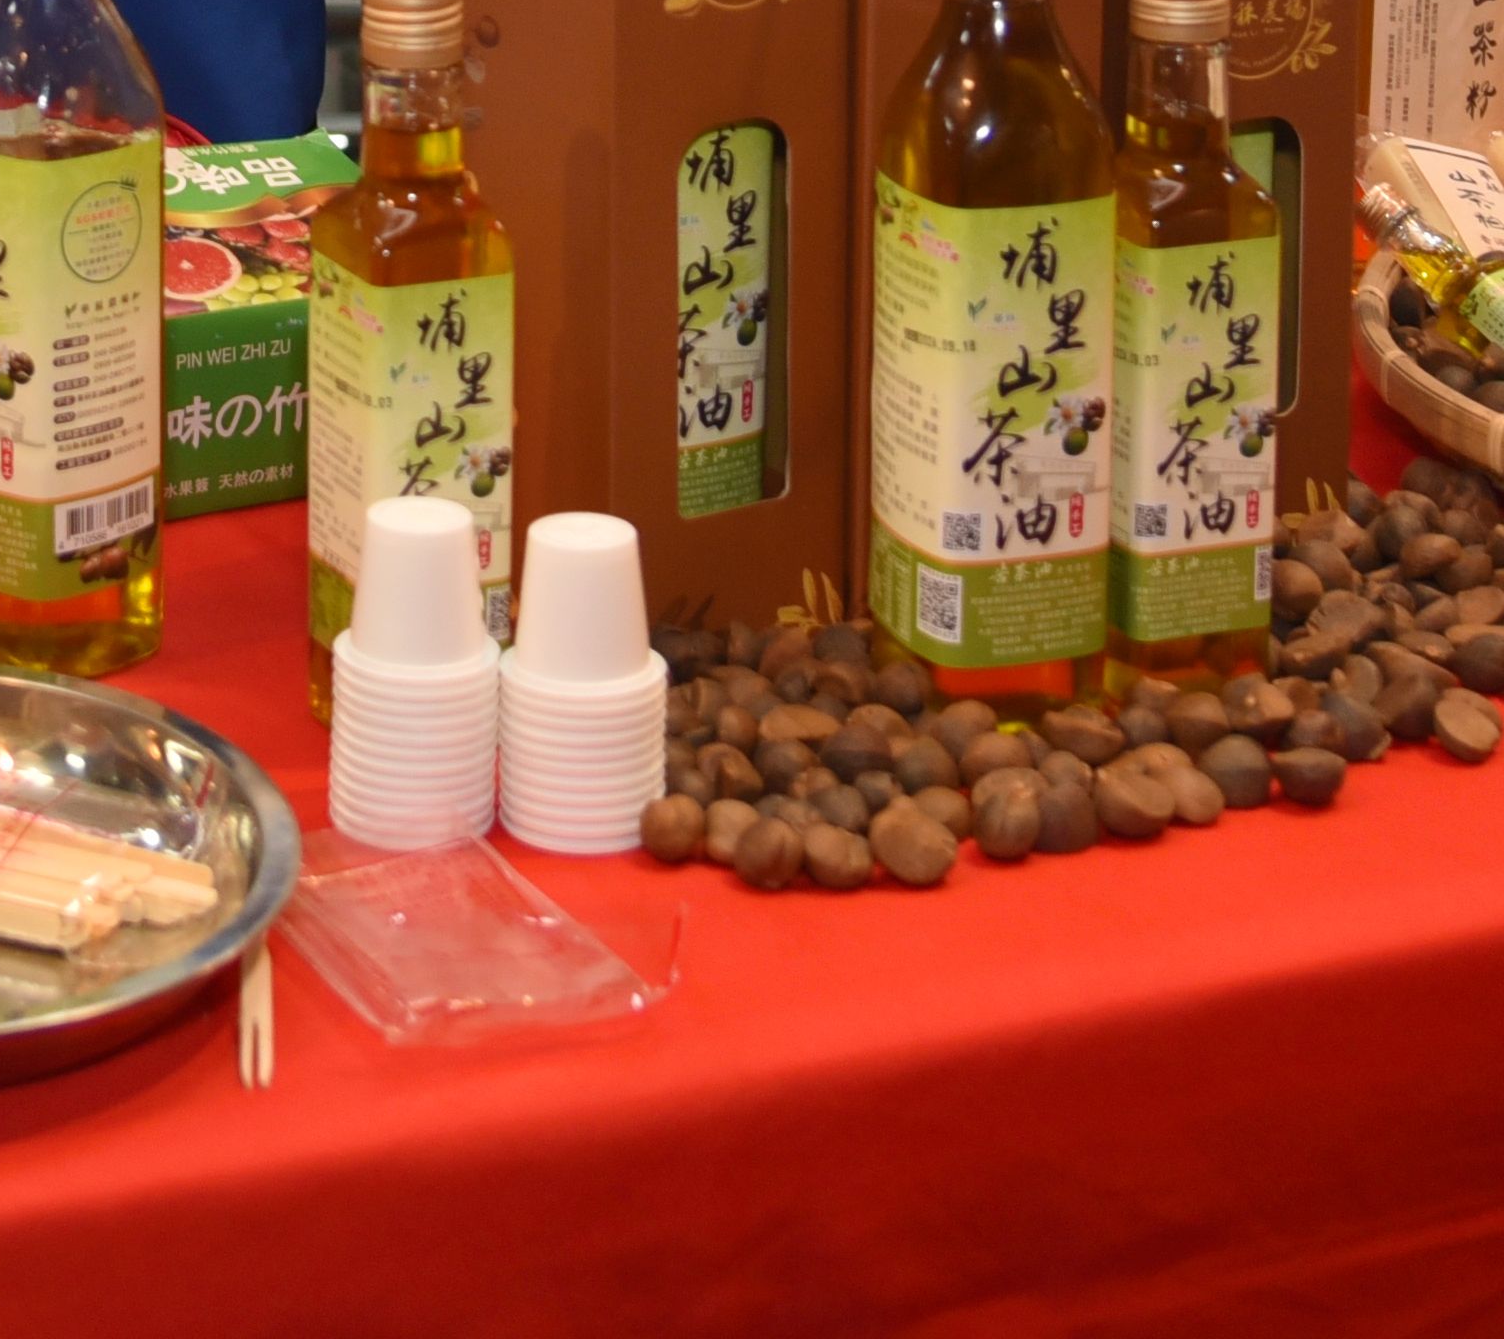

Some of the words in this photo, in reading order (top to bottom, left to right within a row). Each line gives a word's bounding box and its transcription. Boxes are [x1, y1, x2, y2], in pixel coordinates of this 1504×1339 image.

[175, 352, 203, 371] PIN
[207, 348, 238, 366] WEI
[240, 343, 268, 361] ZHI
[270, 338, 292, 356] ZU
[397, 288, 494, 498] 埔里山茶
[962, 217, 1088, 550] 埔里山茶油
[1156, 251, 1261, 541] 埔里山茶油
[218, 463, 296, 491] 天然の素材
